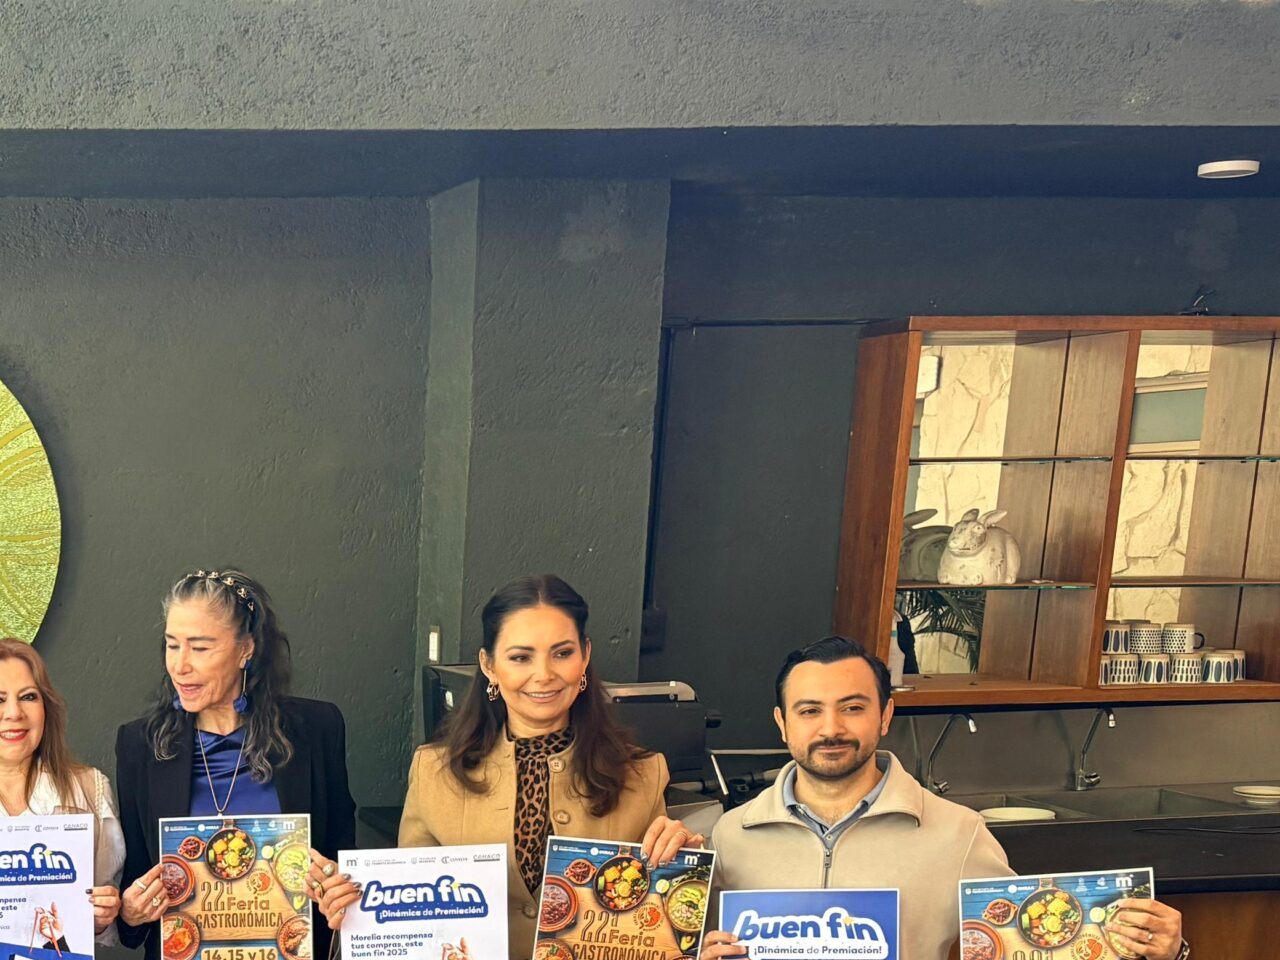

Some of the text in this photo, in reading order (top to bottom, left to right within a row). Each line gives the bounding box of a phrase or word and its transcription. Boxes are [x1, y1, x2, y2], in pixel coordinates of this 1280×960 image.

[31, 846, 70, 869] fin
[28, 872, 73, 881] Premiación!
[364, 879, 481, 907] buen fin
[227, 897, 269, 910] Feria
[379, 905, 484, 919] ¡Dinámica de Premiación!
[196, 911, 283, 929] GASTRONÓMICA
[738, 913, 879, 941] buen fin
[351, 933, 381, 941] Morelia
[608, 930, 654, 948] Feria
[366, 942, 404, 950] compras,
[386, 948, 408, 956] 2025
[754, 945, 882, 955] ¡Dinámica de Premiación!
[259, 949, 276, 960] 16
